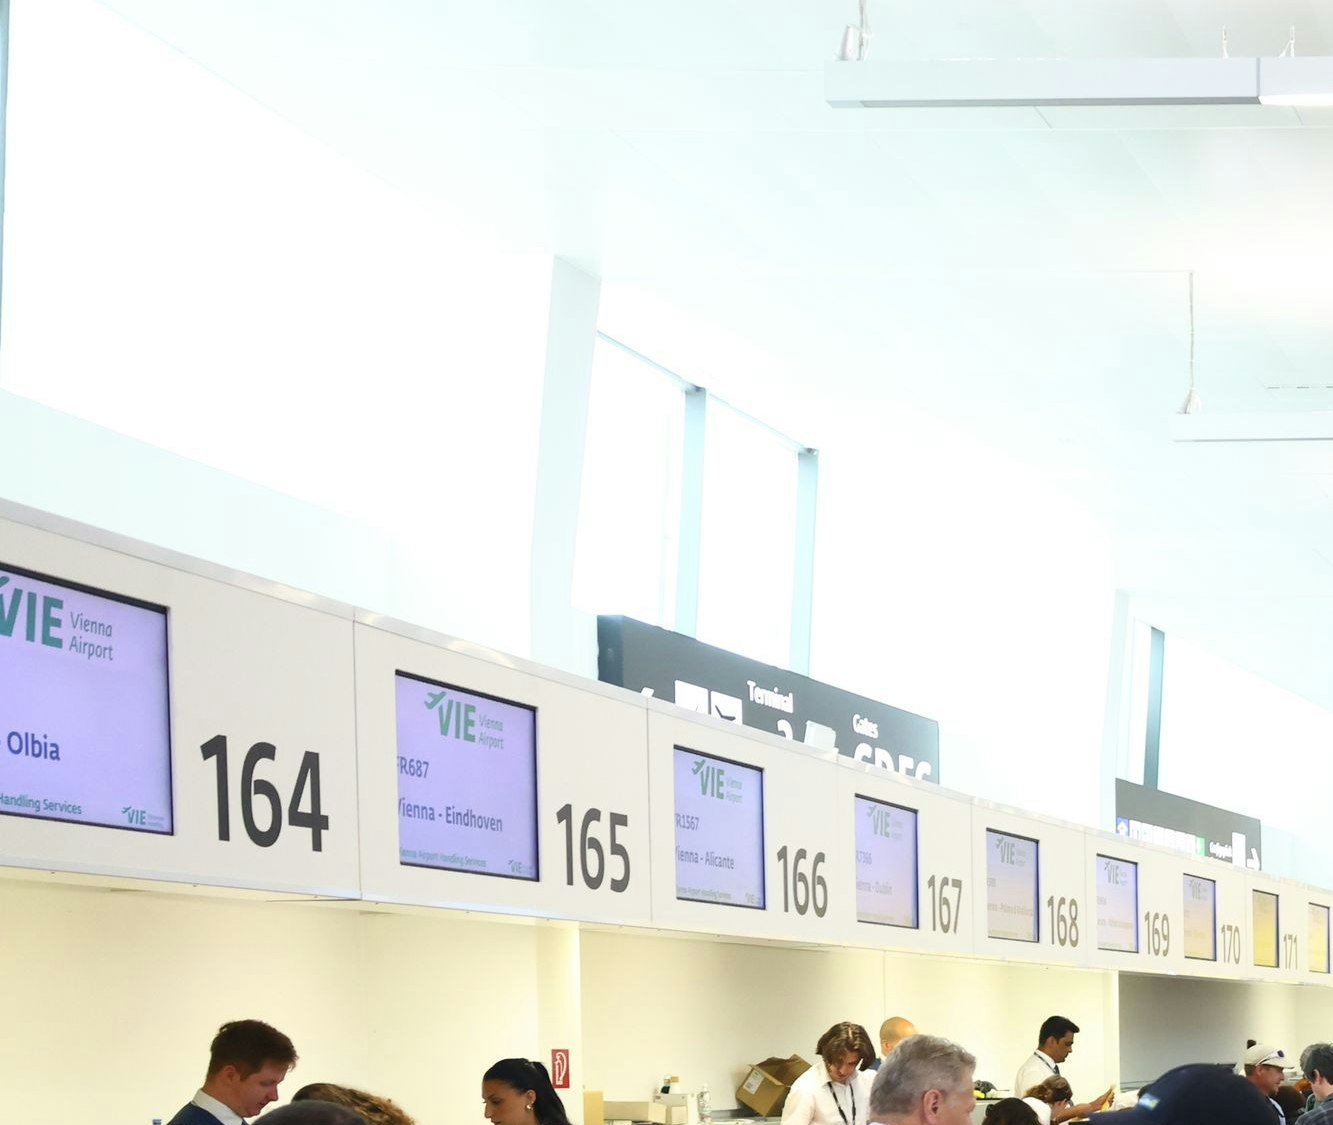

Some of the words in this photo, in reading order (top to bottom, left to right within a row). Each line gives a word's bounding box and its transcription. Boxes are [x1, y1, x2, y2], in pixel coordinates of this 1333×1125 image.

[0, 587, 64, 649] VIE
[70, 611, 113, 637] Vienna
[69, 635, 113, 661] Airport
[747, 680, 793, 713] Terminal
[438, 699, 476, 743] VIE
[479, 715, 503, 732] Vienna
[7, 731, 61, 761] Olbia
[479, 732, 504, 750] Airport
[200, 734, 329, 852] 164
[700, 765, 725, 799] VIE
[43, 798, 82, 815] Services
[127, 808, 146, 826] VIE
[445, 805, 503, 832] Eindhoven
[873, 809, 890, 838] VIE
[556, 803, 631, 893] 165
[705, 851, 735, 870] Alicante
[1001, 841, 1015, 865] VIE
[776, 845, 829, 918] 166
[927, 874, 963, 935] 167
[1047, 896, 1079, 947] 168
[1144, 911, 1170, 957] 169
[1221, 924, 1241, 965] 170
[1283, 933, 1299, 971] 171
